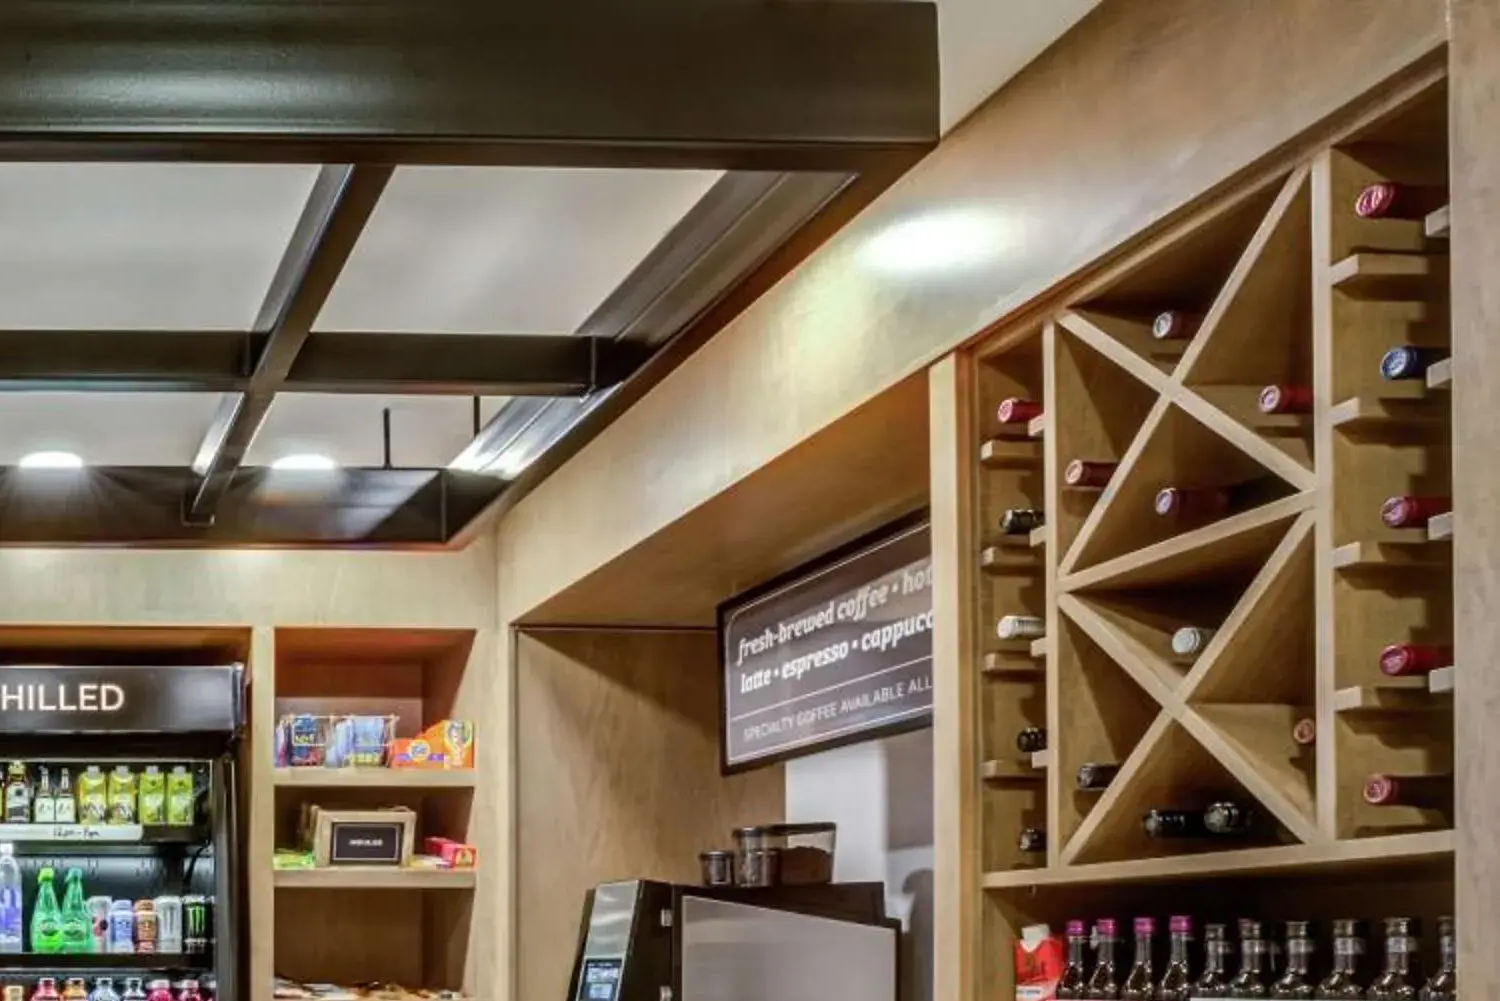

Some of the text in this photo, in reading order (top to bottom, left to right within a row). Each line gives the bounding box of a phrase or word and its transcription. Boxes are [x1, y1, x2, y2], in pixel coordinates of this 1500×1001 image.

[737, 601, 835, 667] fresh-brewed
[837, 583, 889, 621] coffee
[740, 669, 772, 694] latte
[782, 640, 849, 680] espresso
[743, 717, 795, 743] SPECIALTY
[797, 703, 837, 725] COFFEE
[839, 682, 904, 714] AVAILABLE
